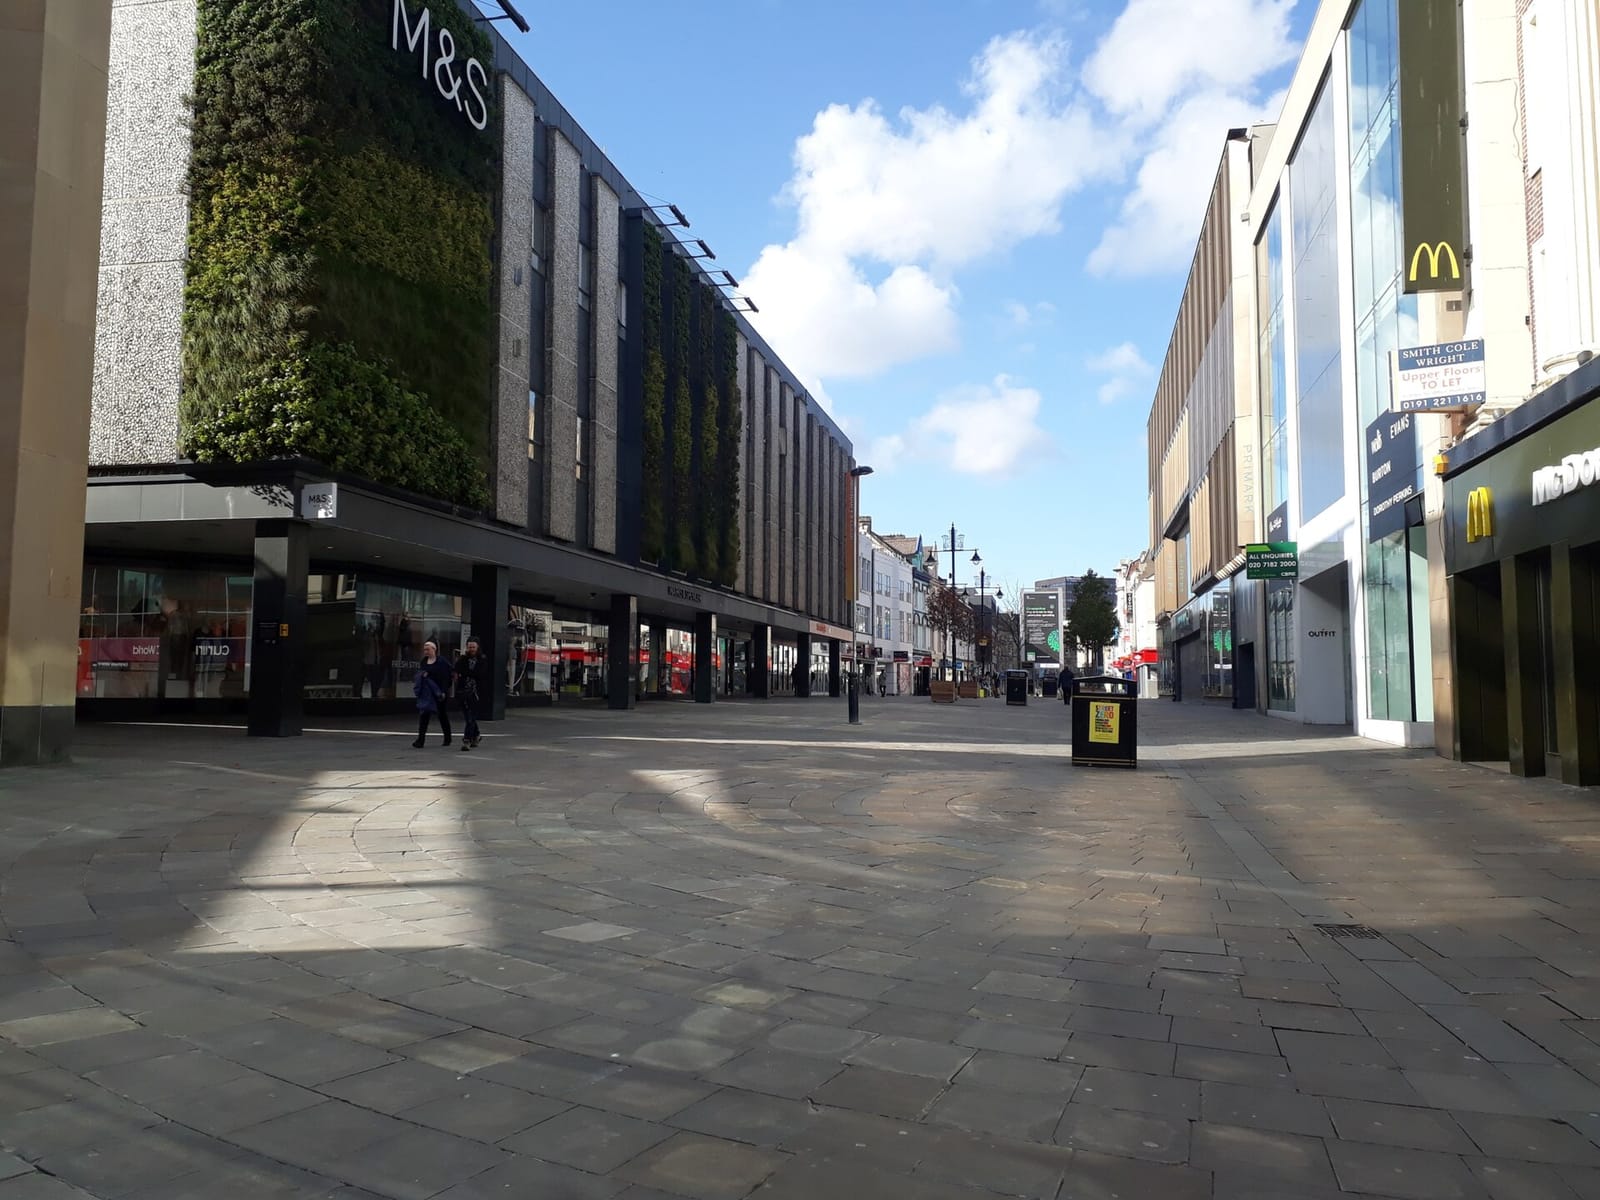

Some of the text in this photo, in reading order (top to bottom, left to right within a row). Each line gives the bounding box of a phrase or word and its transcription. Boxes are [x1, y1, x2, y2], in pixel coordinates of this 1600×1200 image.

[392, 0, 488, 131] M&S
[1402, 341, 1479, 359] SMITH COLE
[1416, 353, 1465, 367] WRIGHT
[1402, 366, 1481, 383] Upper Floors
[1421, 377, 1462, 390] TO LET
[1403, 401, 1428, 409] 0191
[1433, 397, 1453, 406] 221
[1456, 393, 1482, 403] 1616
[1390, 413, 1410, 440] EVANS
[1243, 444, 1254, 513] PRIMARK
[1372, 460, 1392, 484] BURTON
[308, 494, 327, 504] M&S
[1373, 485, 1413, 516] DOROTHY PERKINS
[1308, 630, 1336, 638] OUTFIT
